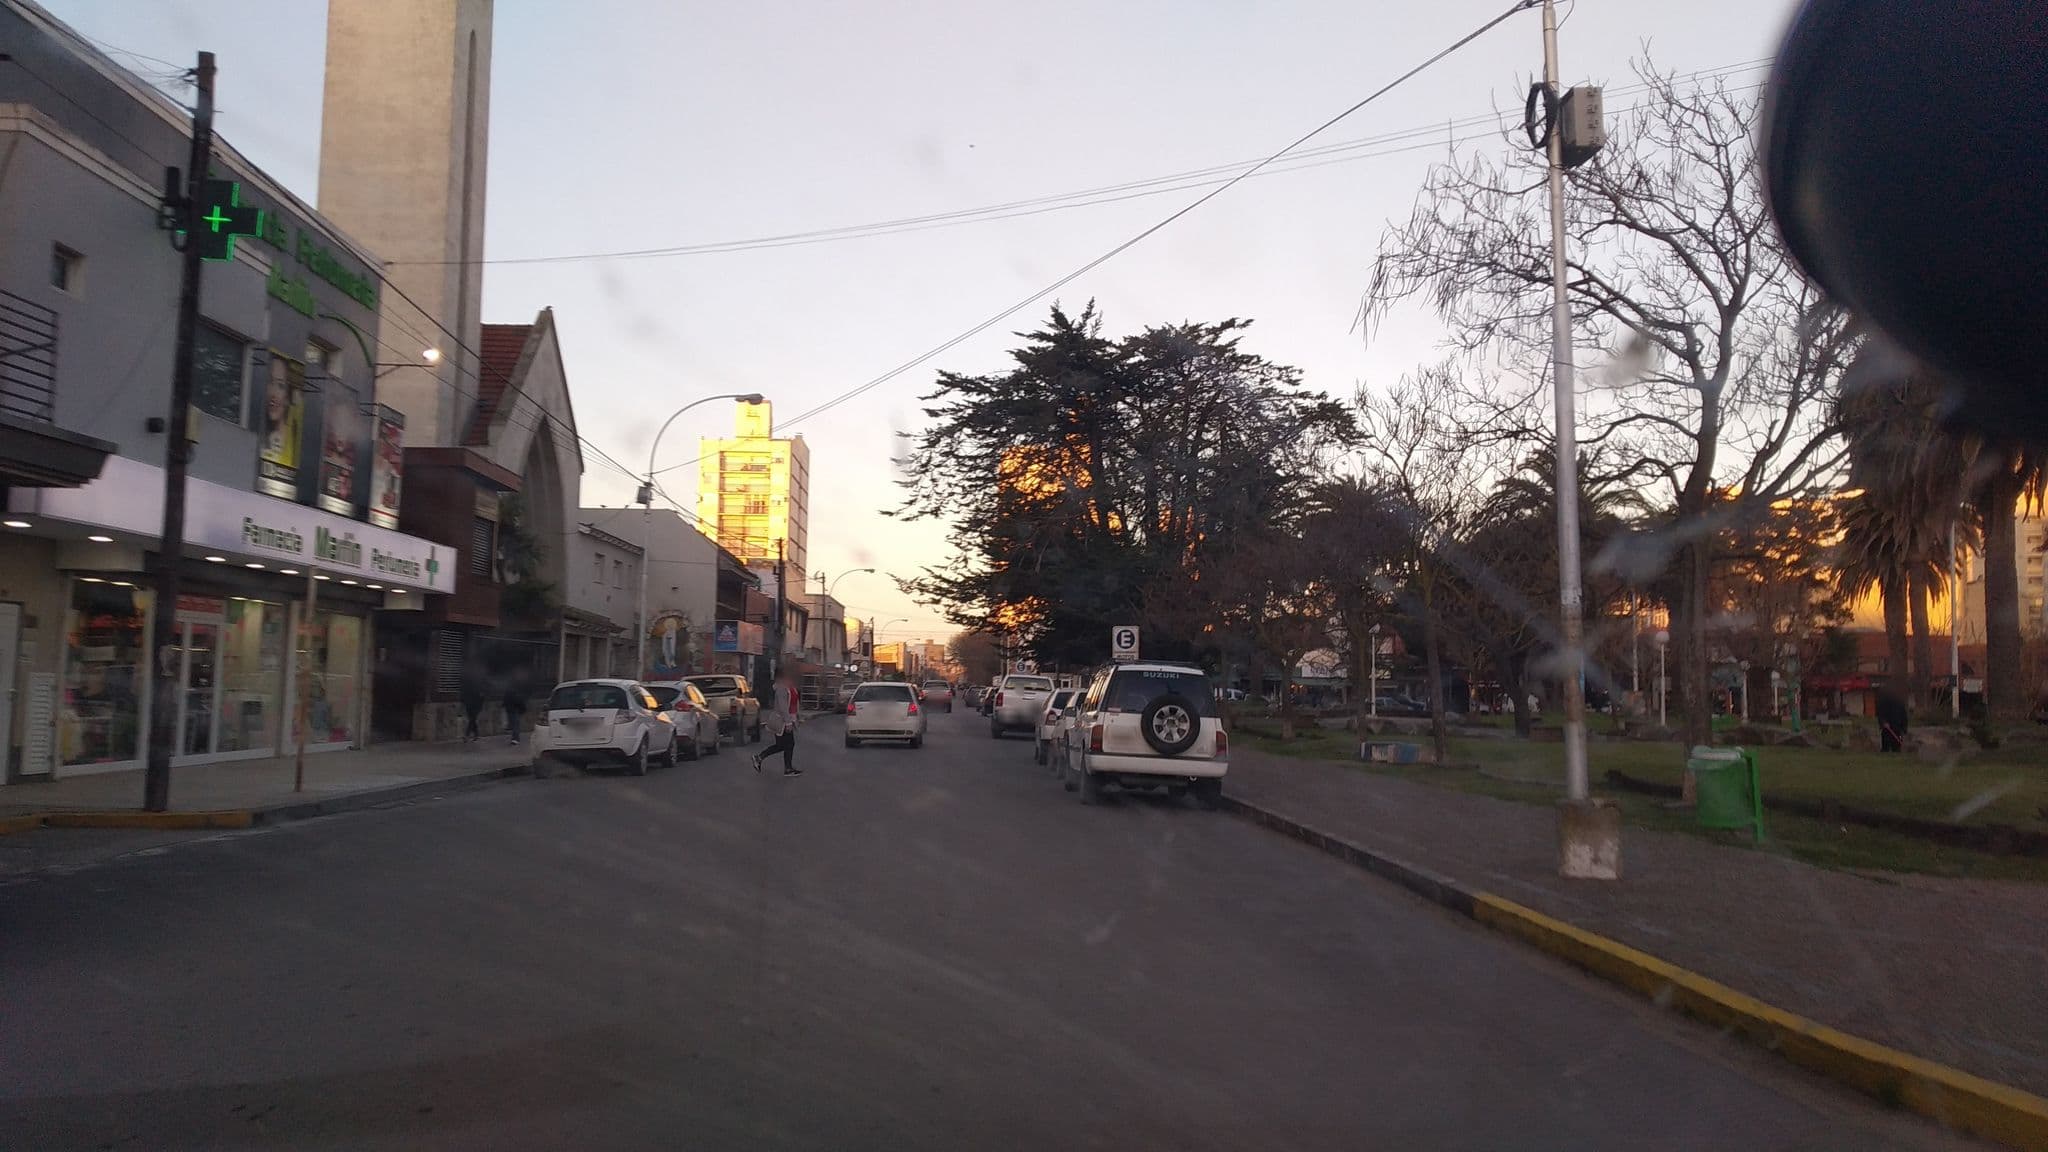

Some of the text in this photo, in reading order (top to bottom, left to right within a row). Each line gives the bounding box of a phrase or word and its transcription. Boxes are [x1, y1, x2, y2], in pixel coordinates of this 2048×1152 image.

[242, 516, 303, 554] Farmacia
[1120, 631, 1131, 648] E
[1143, 671, 1180, 679] SUZUKI
